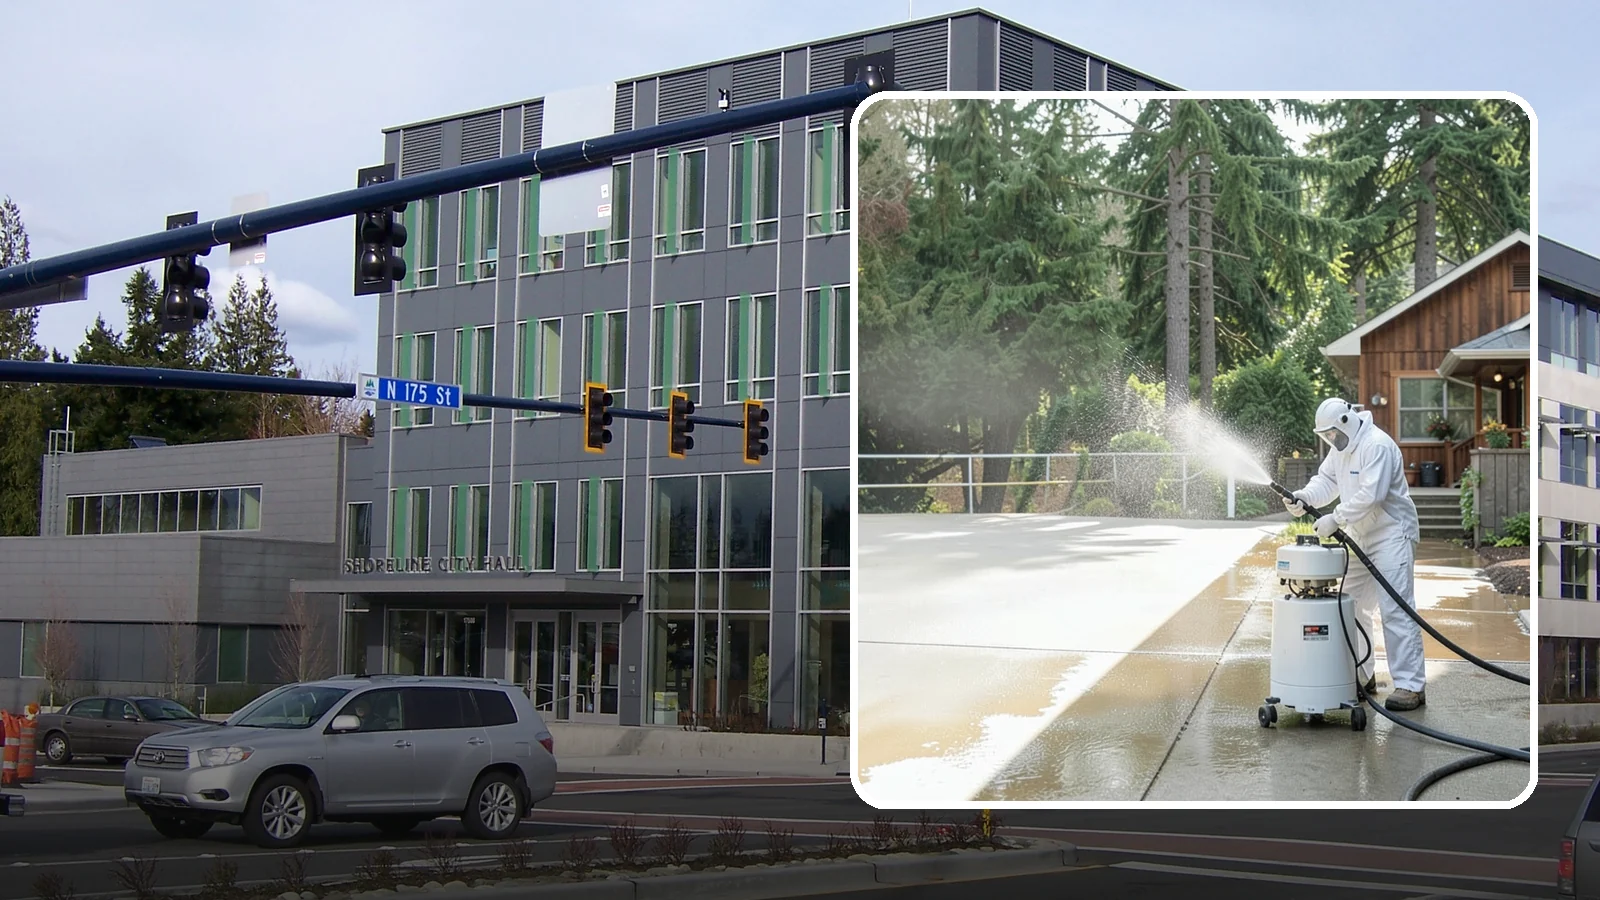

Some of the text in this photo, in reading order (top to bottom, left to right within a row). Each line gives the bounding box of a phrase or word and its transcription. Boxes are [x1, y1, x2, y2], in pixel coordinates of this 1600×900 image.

[387, 380, 451, 406] N 175 St
[344, 555, 525, 574] SHORELINE CITY HALL
